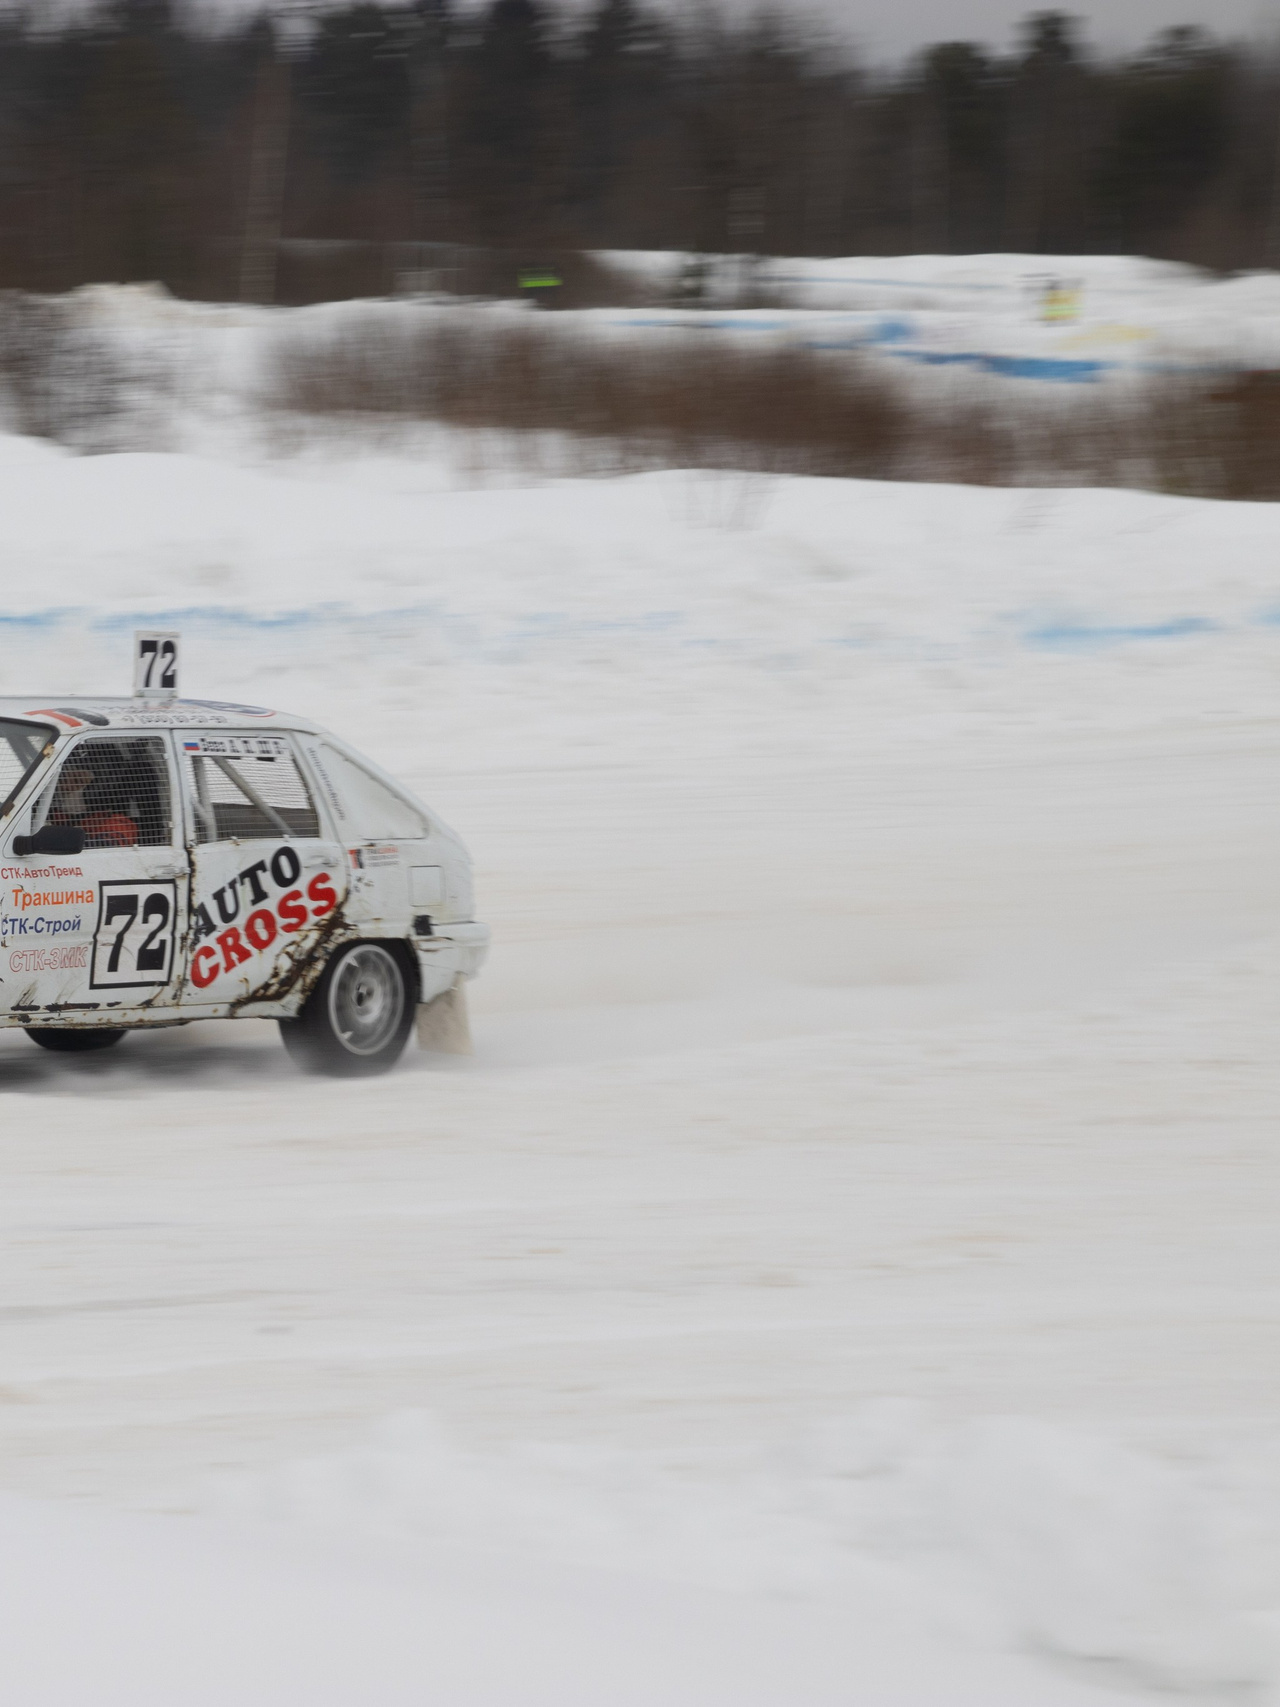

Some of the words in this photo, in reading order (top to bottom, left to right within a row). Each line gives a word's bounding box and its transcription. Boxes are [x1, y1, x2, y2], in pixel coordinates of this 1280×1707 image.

[140, 640, 177, 688] 72
[12, 888, 94, 911] Тракшина
[192, 846, 301, 947] AUTO
[1, 915, 81, 936] СТК-Строй
[104, 892, 170, 972] 72
[190, 872, 337, 988] CROSS
[9, 946, 88, 973] СТК-ЗМК
